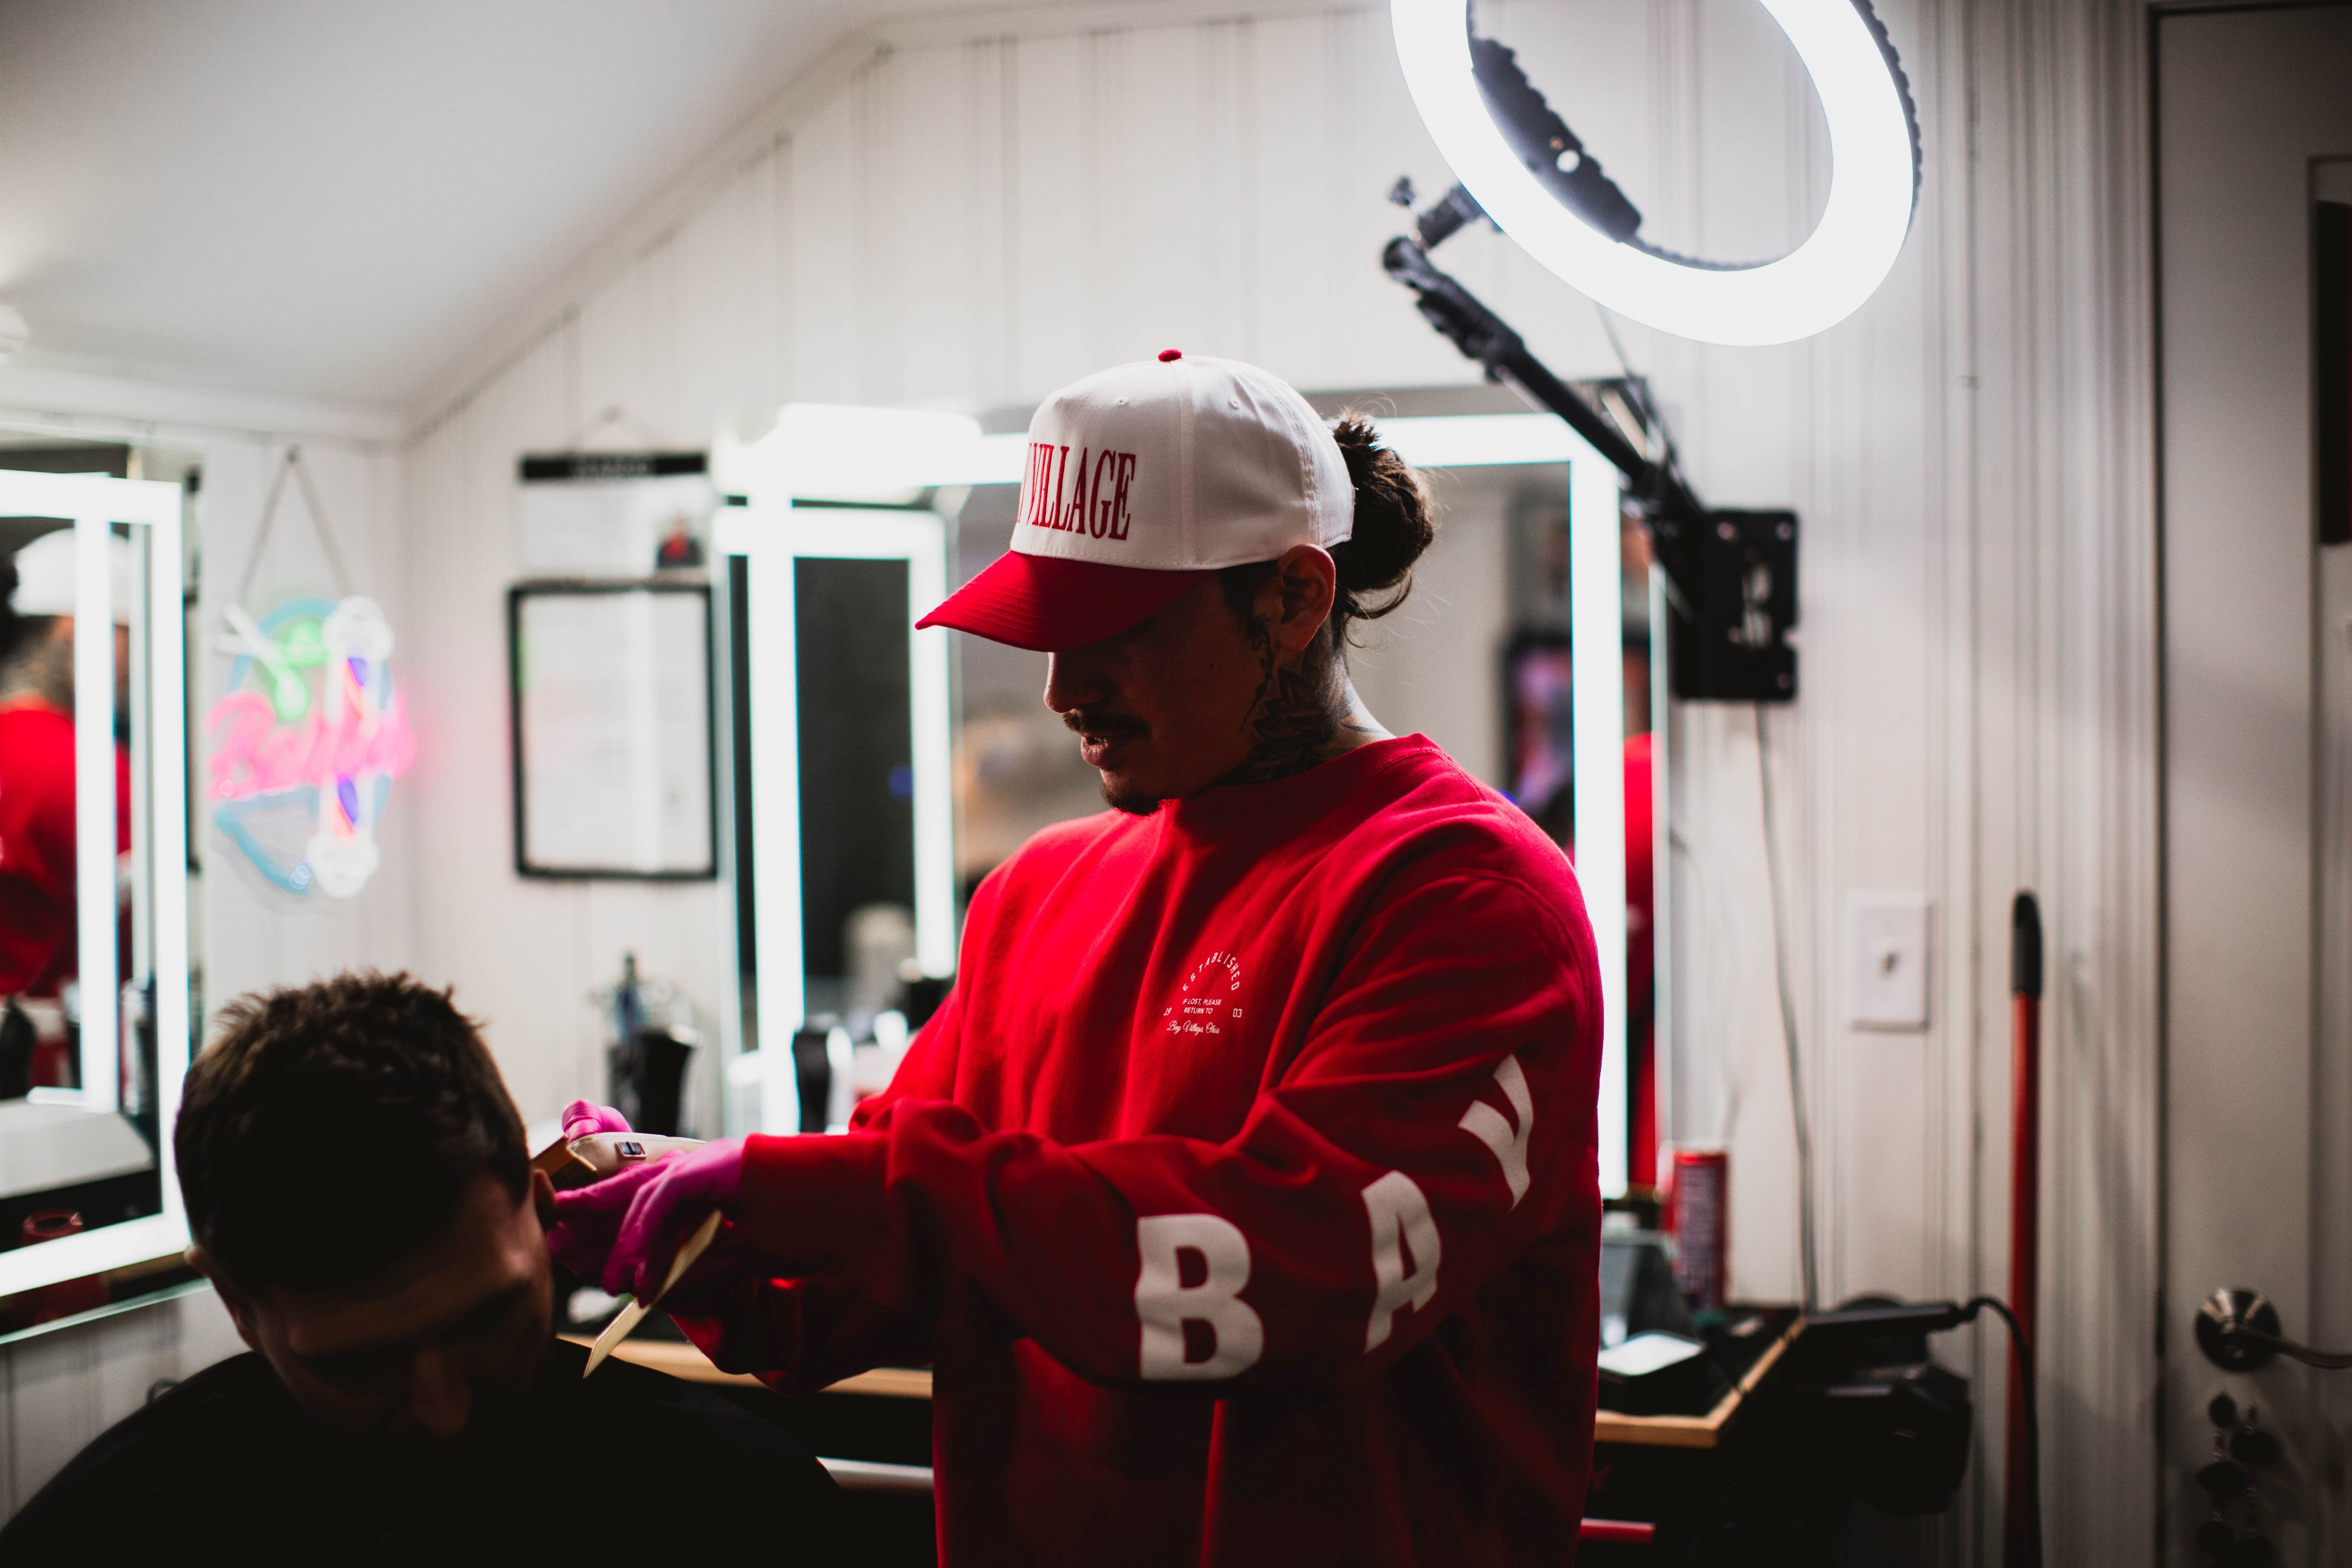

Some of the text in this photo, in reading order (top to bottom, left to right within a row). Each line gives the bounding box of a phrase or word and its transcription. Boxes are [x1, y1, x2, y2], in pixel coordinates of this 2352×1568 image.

[1026, 443, 1136, 540] VILLAGE
[1182, 951, 1240, 991] ESTABLISHED
[1163, 1007, 1172, 1016] 19
[1232, 1008, 1242, 1018] 03
[1166, 1020, 1181, 1034] Bay
[1206, 1022, 1220, 1034] Ohio
